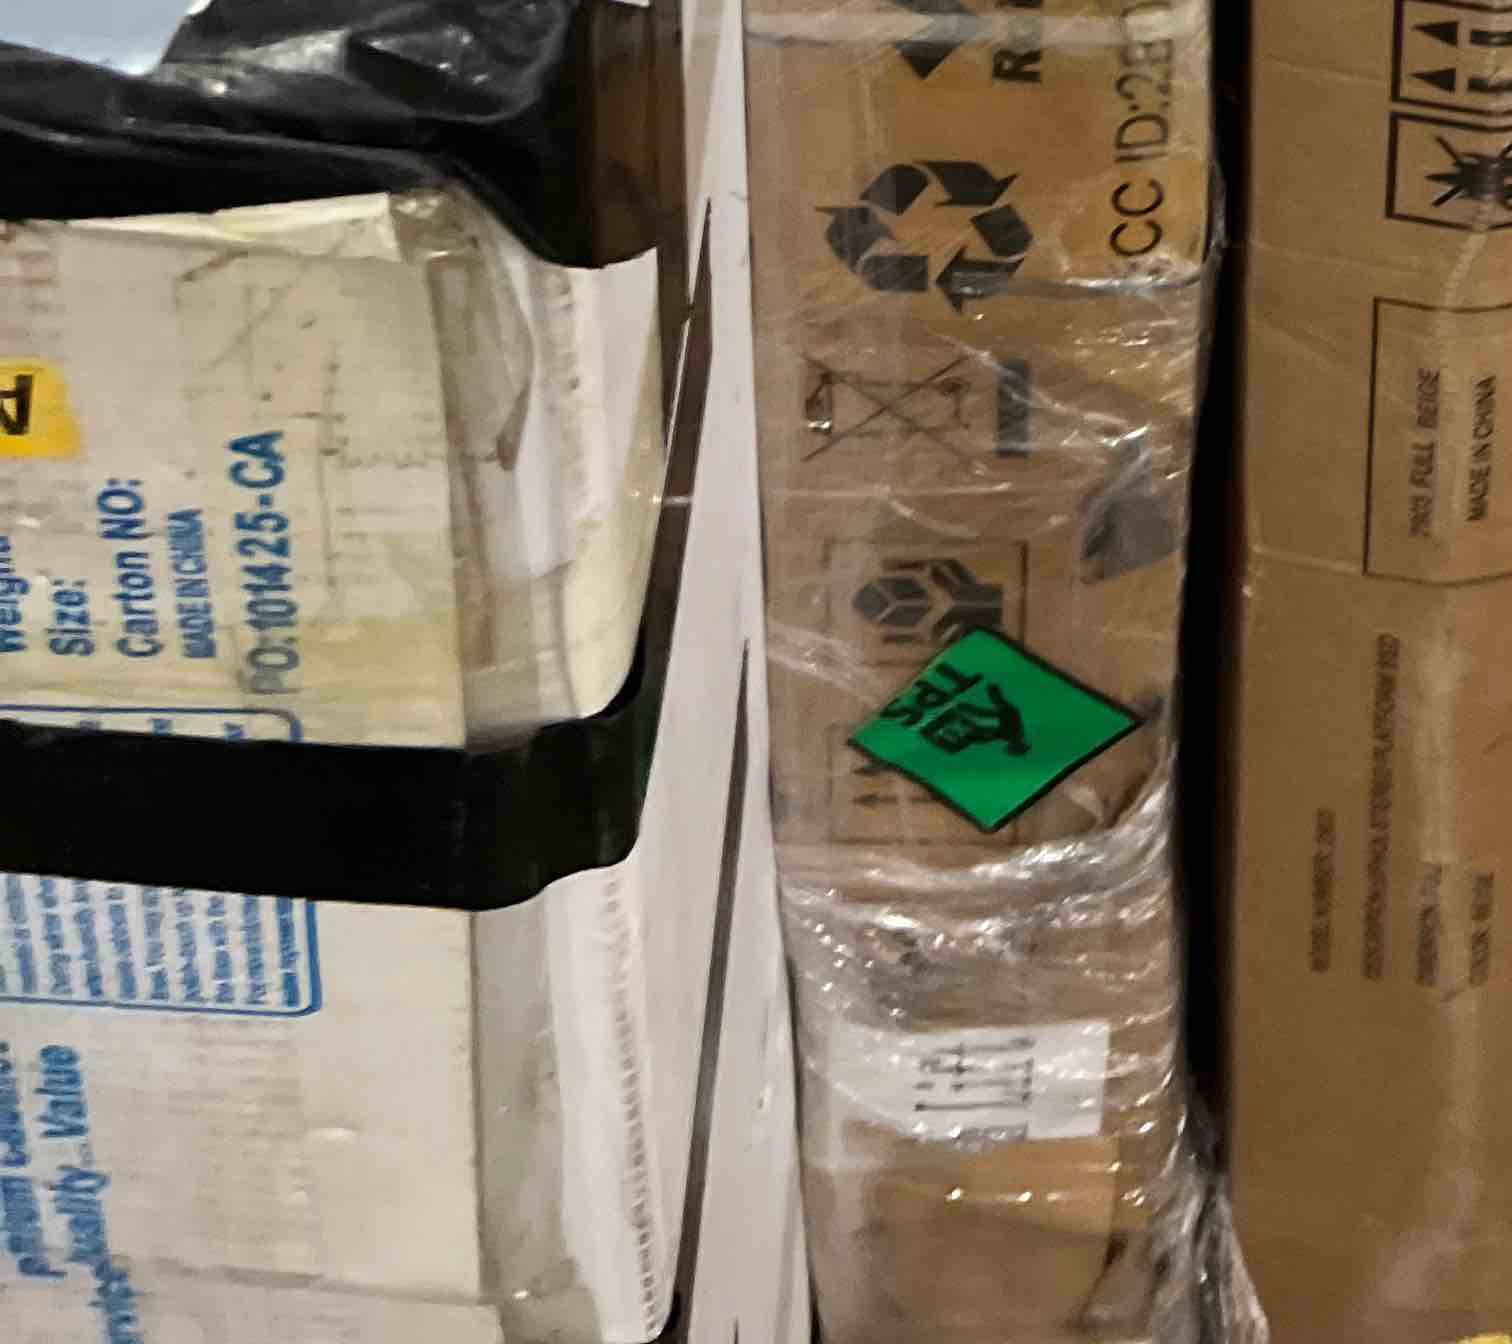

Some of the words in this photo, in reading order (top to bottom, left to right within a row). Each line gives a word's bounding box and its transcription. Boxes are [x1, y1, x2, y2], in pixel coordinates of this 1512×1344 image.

[1110, 178, 1166, 256] CC
[1472, 375, 1497, 441] CHINA
[97, 477, 148, 540] NO:
[1464, 466, 1492, 523] MADE
[167, 508, 208, 576] CHINA
[46, 578, 95, 657] Size:
[112, 551, 165, 658] Carton
[174, 577, 210, 599] IN
[175, 601, 217, 659] MADE
